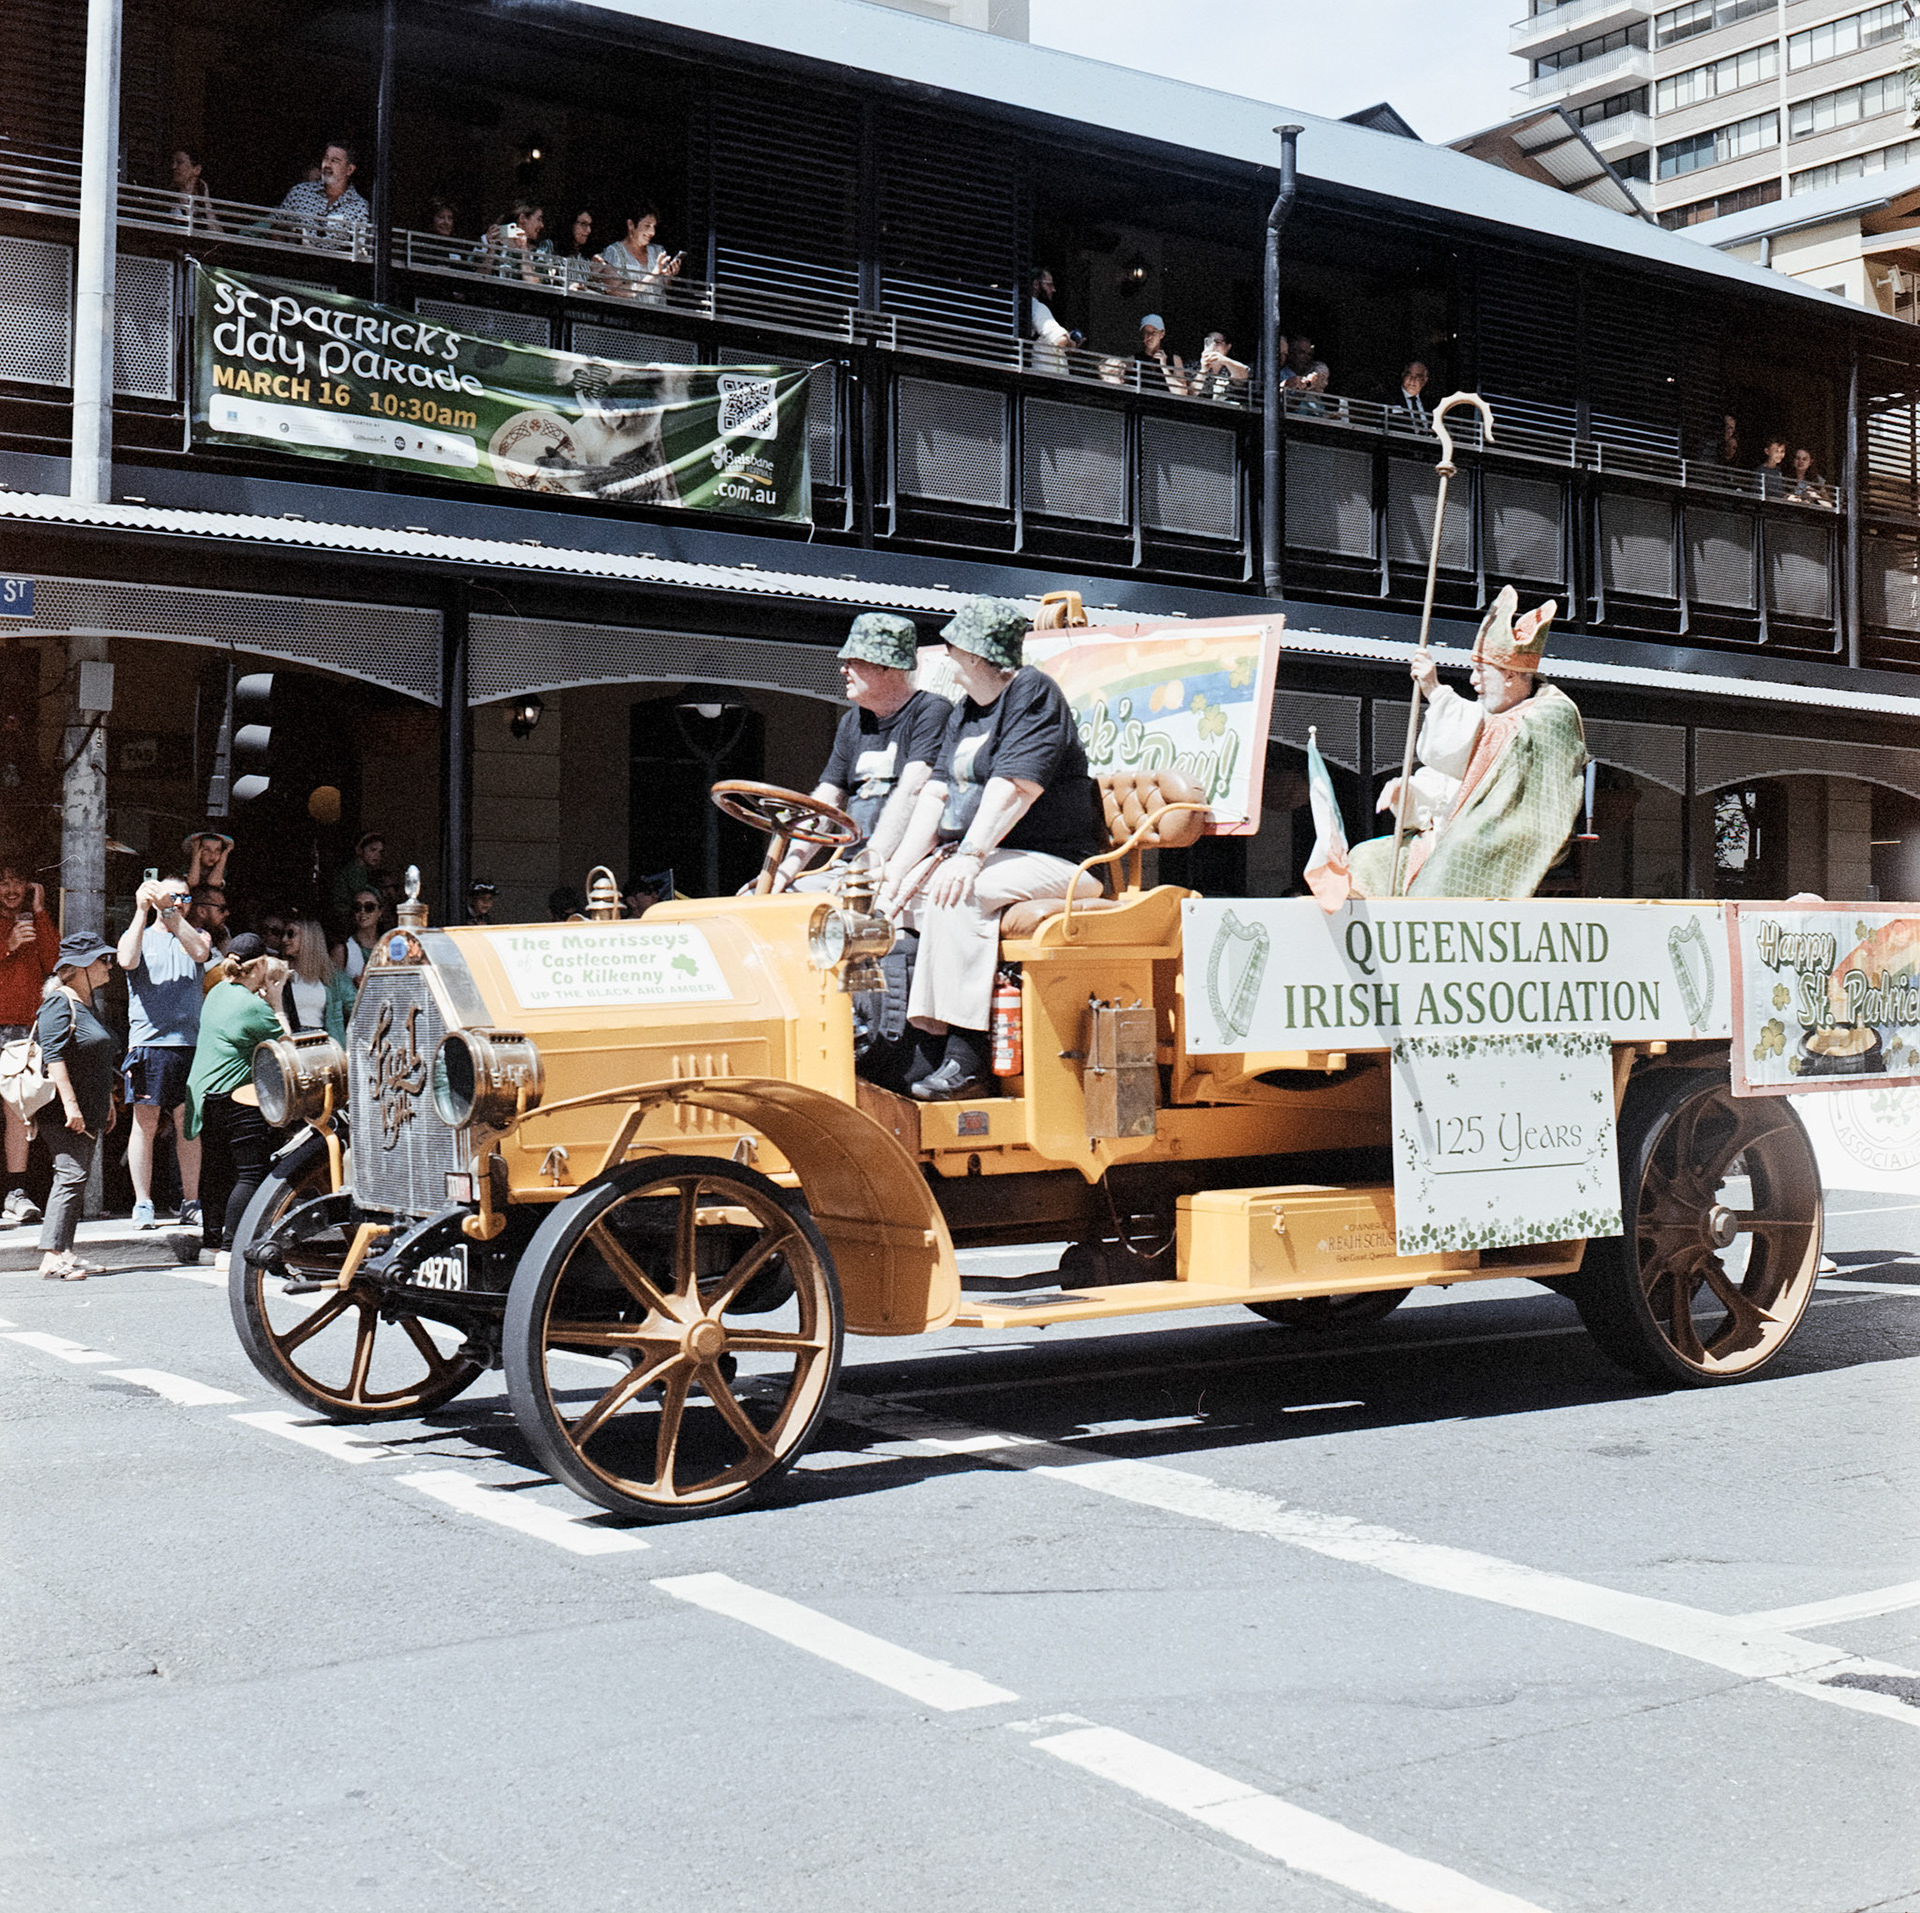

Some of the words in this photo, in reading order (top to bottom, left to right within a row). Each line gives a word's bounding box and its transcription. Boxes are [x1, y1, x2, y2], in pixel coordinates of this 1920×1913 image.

[212, 364, 310, 402] MARCH
[318, 382, 350, 406] 16
[369, 391, 477, 430] 10:30am
[713, 482, 777, 505] .com.au
[3, 579, 27, 603] ST
[508, 936, 550, 952] The
[562, 931, 690, 951] Morrisseys
[1345, 920, 1609, 975] QUEENSLAND
[1757, 919, 1835, 975] Happy
[542, 953, 657, 968] Castlecomer
[551, 971, 573, 985] Co
[582, 968, 664, 986] Kilkenny
[530, 990, 550, 1000] UP
[555, 989, 583, 999] THE
[587, 986, 631, 998] BLACK
[637, 985, 664, 996] AND
[669, 983, 717, 995] AMBER
[1283, 983, 1402, 1028] IRISH
[1414, 980, 1660, 1025] ASSOCIATION
[1797, 971, 1835, 1031] St.
[1843, 969, 1920, 1028] Patric
[1435, 1116, 1485, 1155] 125
[1498, 1112, 1582, 1163] Years
